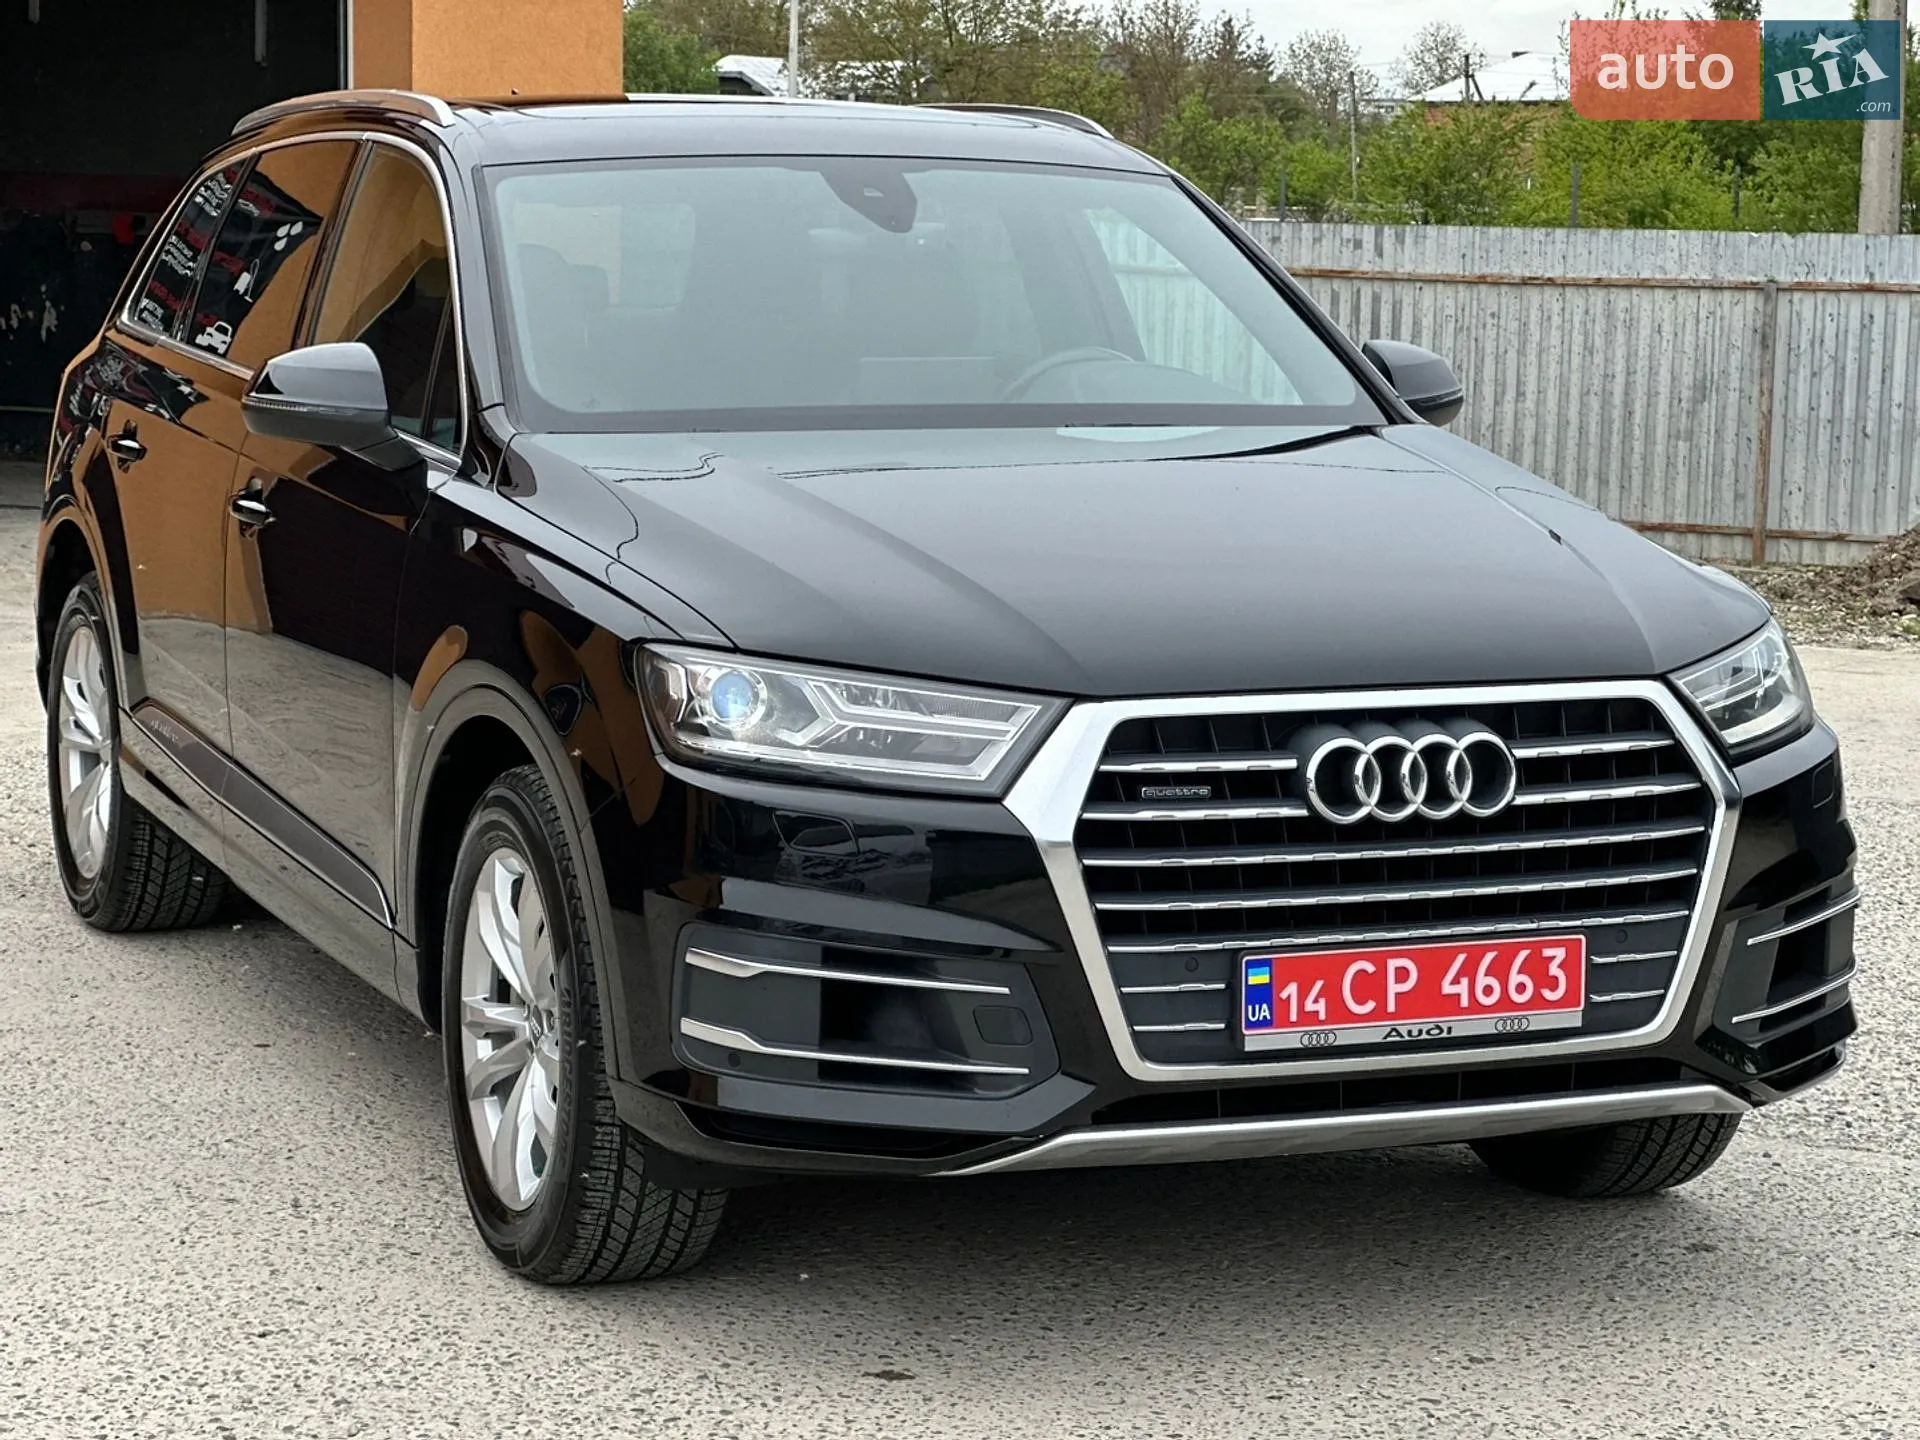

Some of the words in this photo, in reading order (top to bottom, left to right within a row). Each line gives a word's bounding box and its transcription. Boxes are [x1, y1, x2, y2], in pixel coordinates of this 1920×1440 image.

[1146, 788, 1209, 797] quattro
[1278, 979, 1326, 1023] 14
[1341, 957, 1419, 1016] CP
[1440, 946, 1568, 1009] 4663
[1247, 1004, 1271, 1022] UA
[1381, 1025, 1453, 1040] Audi
